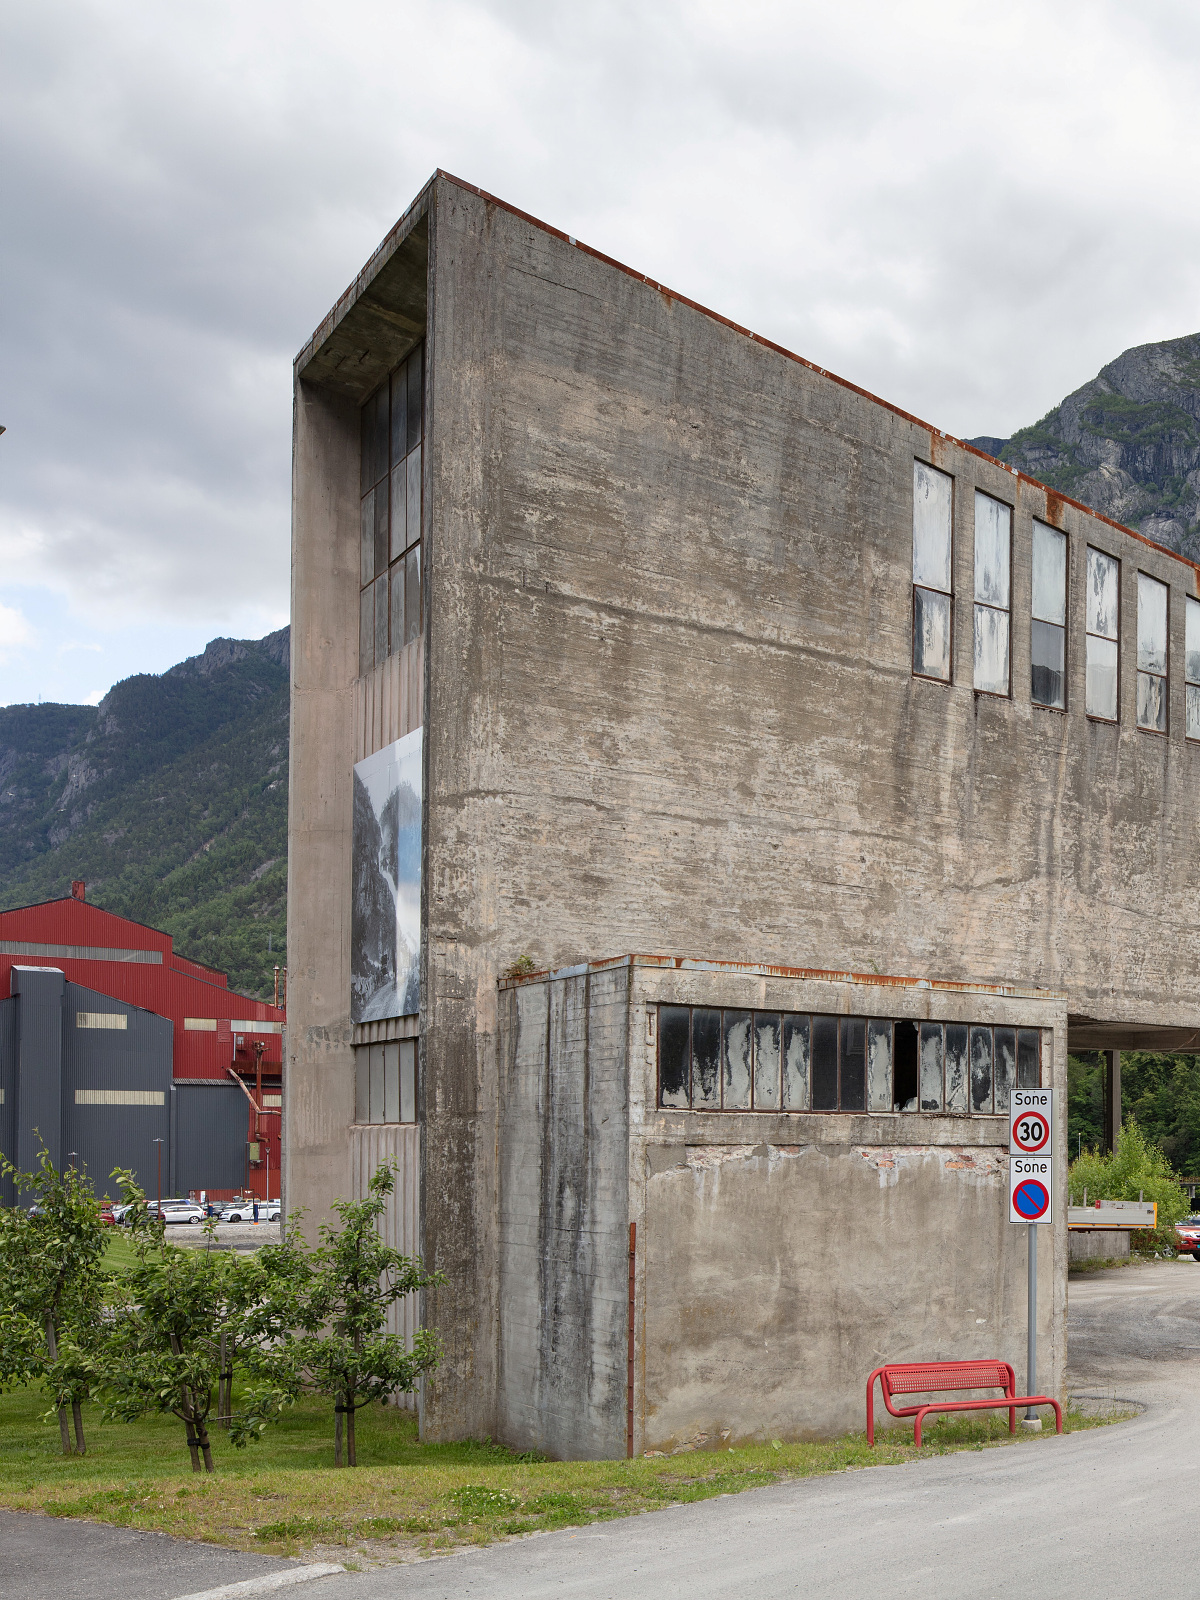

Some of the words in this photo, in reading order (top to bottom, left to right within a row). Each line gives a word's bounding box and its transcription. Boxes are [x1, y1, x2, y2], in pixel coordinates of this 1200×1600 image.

[1015, 1092, 1048, 1106] Sone
[1019, 1121, 1043, 1142] 30
[1015, 1160, 1048, 1173] Sone
